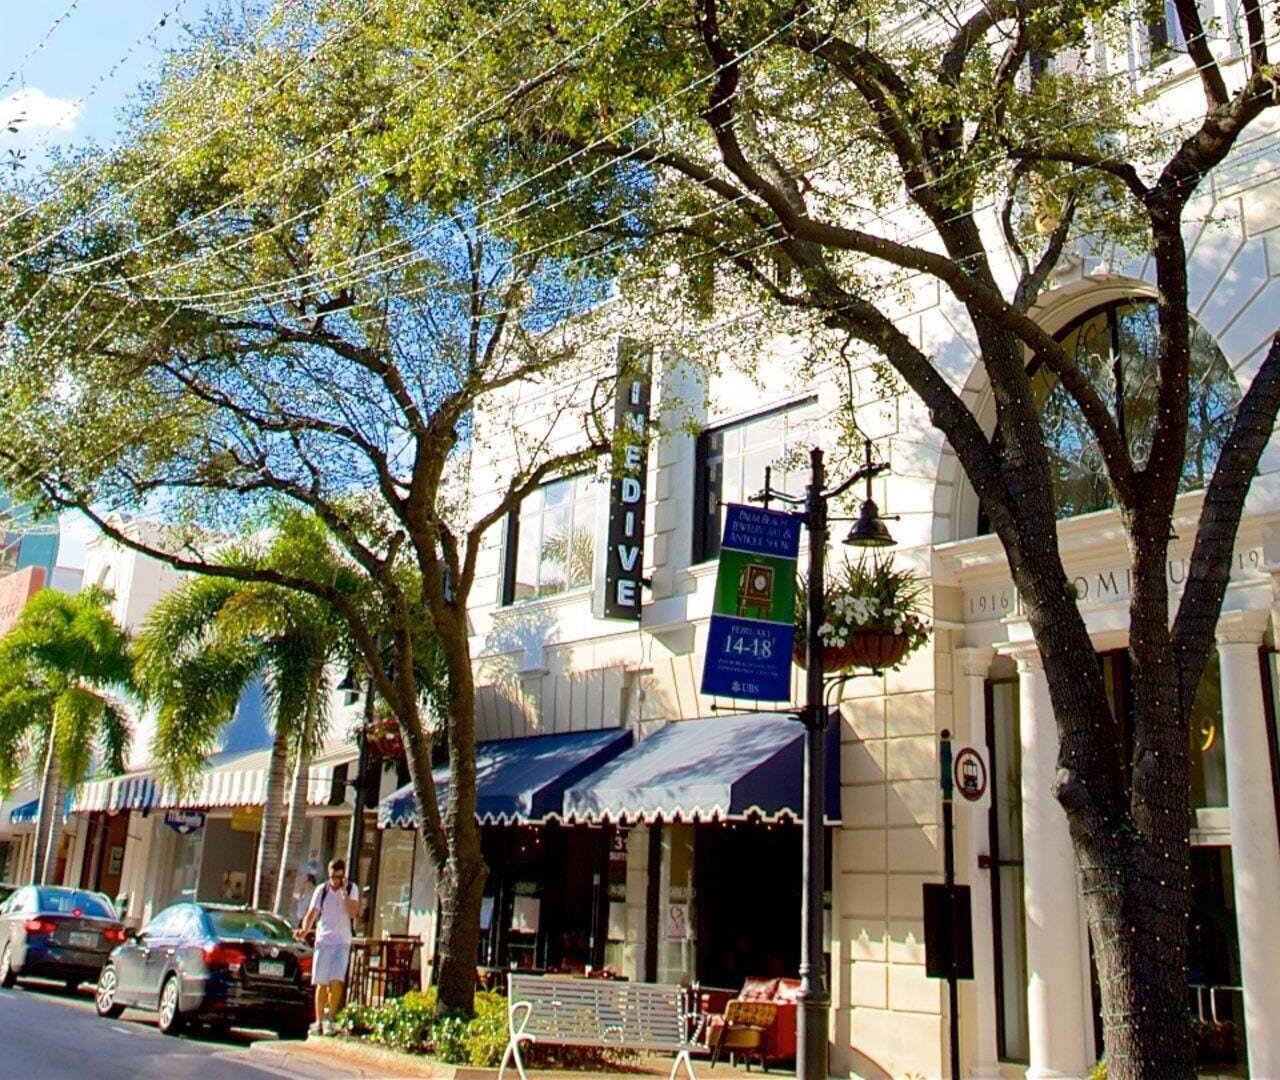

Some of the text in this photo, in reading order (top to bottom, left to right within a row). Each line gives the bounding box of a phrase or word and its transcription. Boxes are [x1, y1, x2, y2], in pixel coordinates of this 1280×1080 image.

[761, 514, 788, 527] BEACH
[768, 528, 782, 538] ART
[783, 528, 792, 540] &
[730, 531, 791, 550] ANTIQUE SHOW
[969, 592, 1009, 615] 1916
[731, 625, 772, 637] FEBRUARY
[742, 683, 760, 694] UBS
